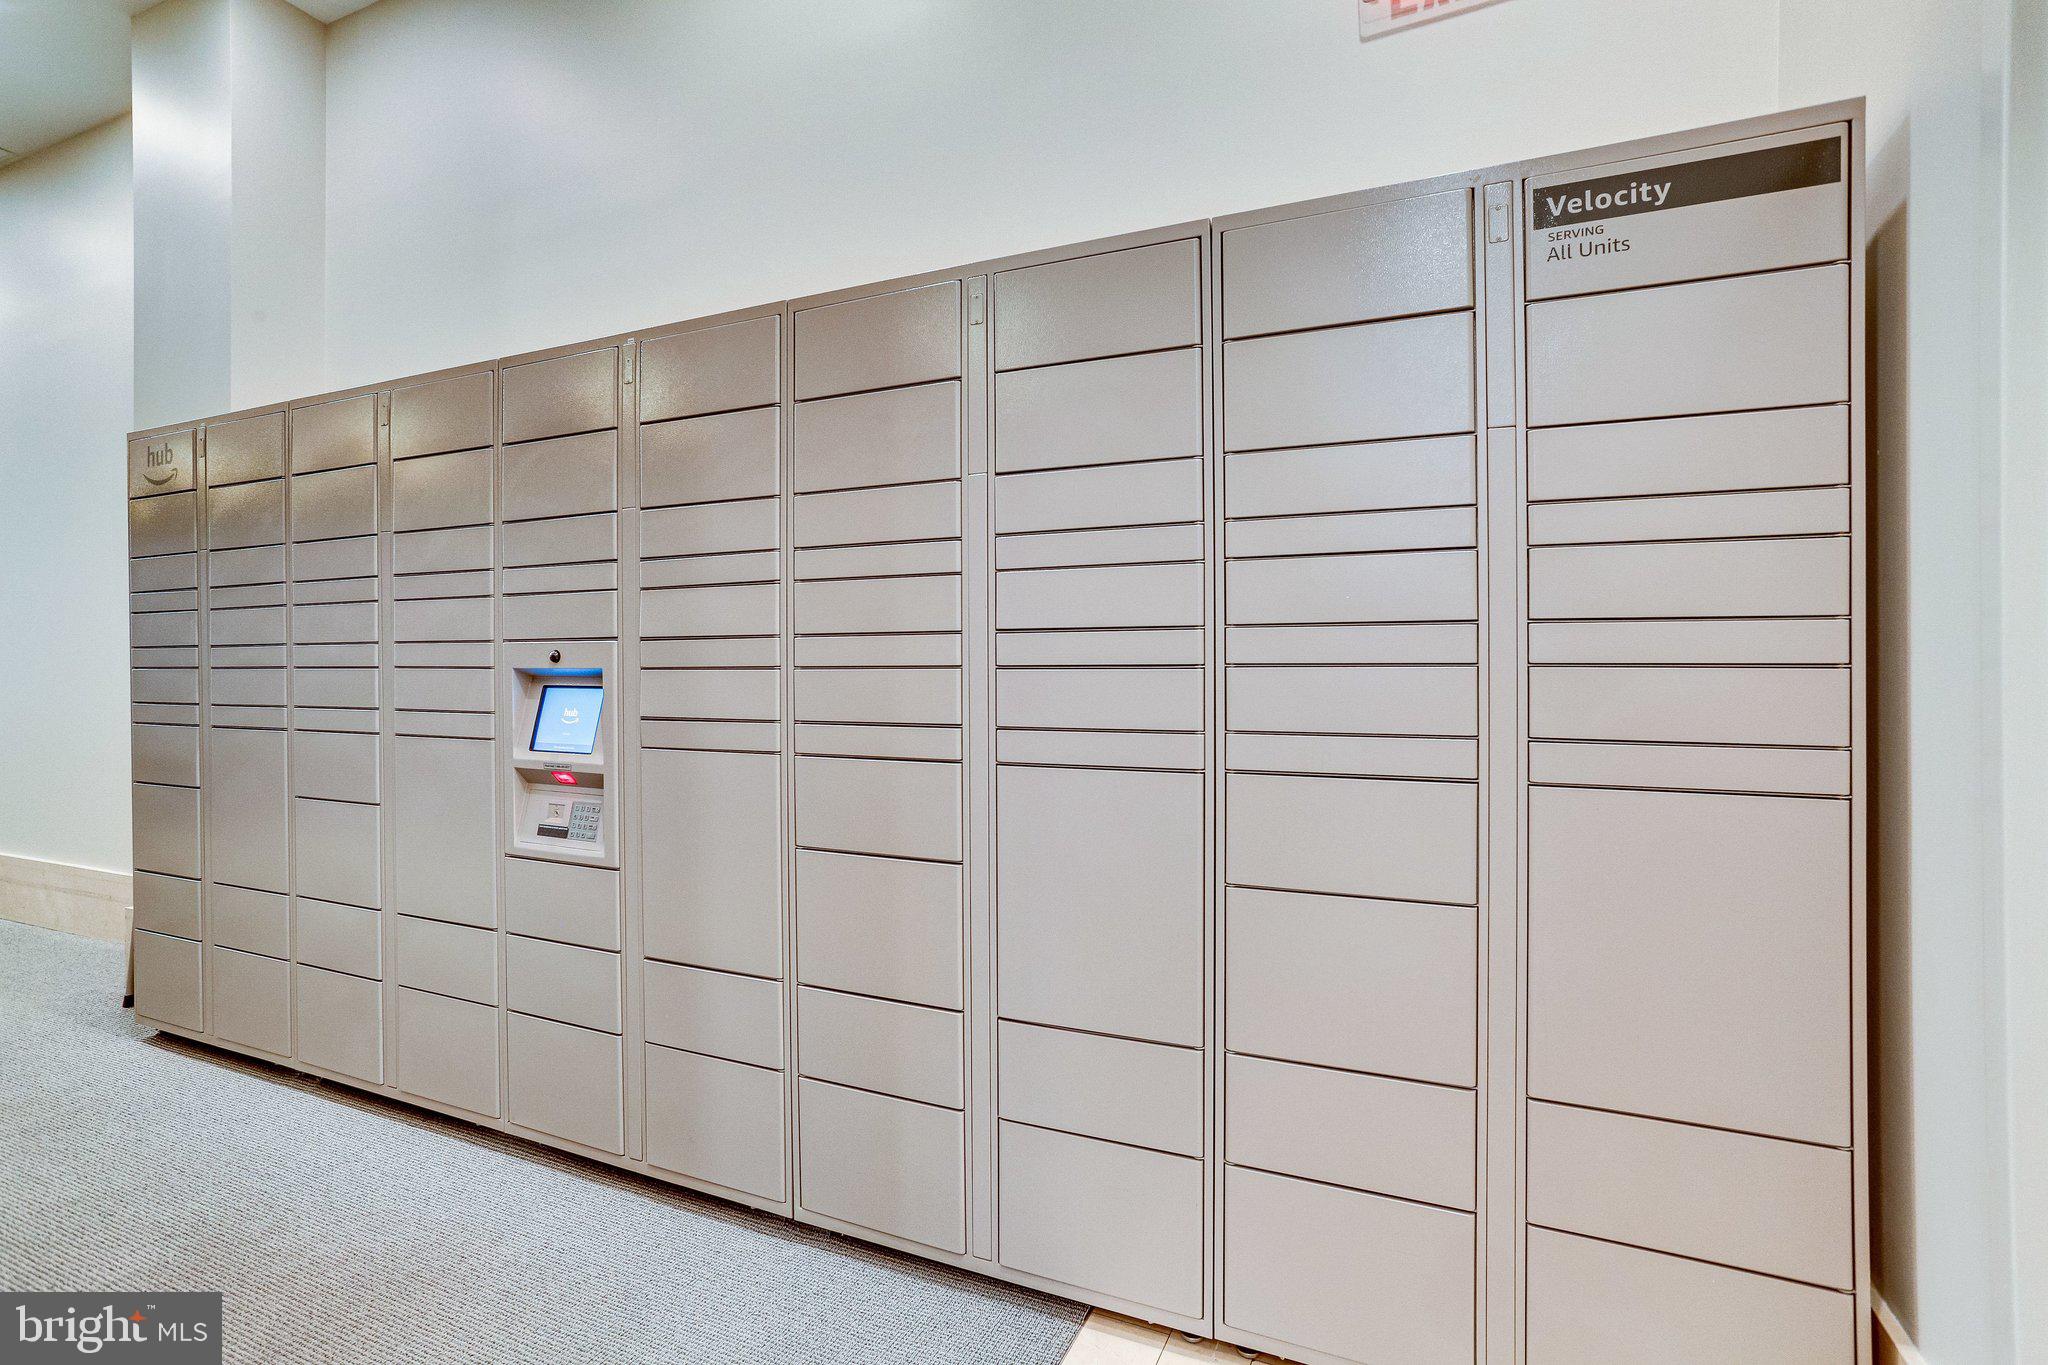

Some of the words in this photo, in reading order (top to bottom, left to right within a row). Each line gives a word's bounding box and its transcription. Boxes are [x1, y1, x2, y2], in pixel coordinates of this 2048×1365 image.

[1546, 181, 1672, 218] Velocity
[1548, 225, 1605, 242] SERVING
[1547, 243, 1571, 262] All
[1579, 237, 1631, 258] Units
[147, 442, 174, 468] hub
